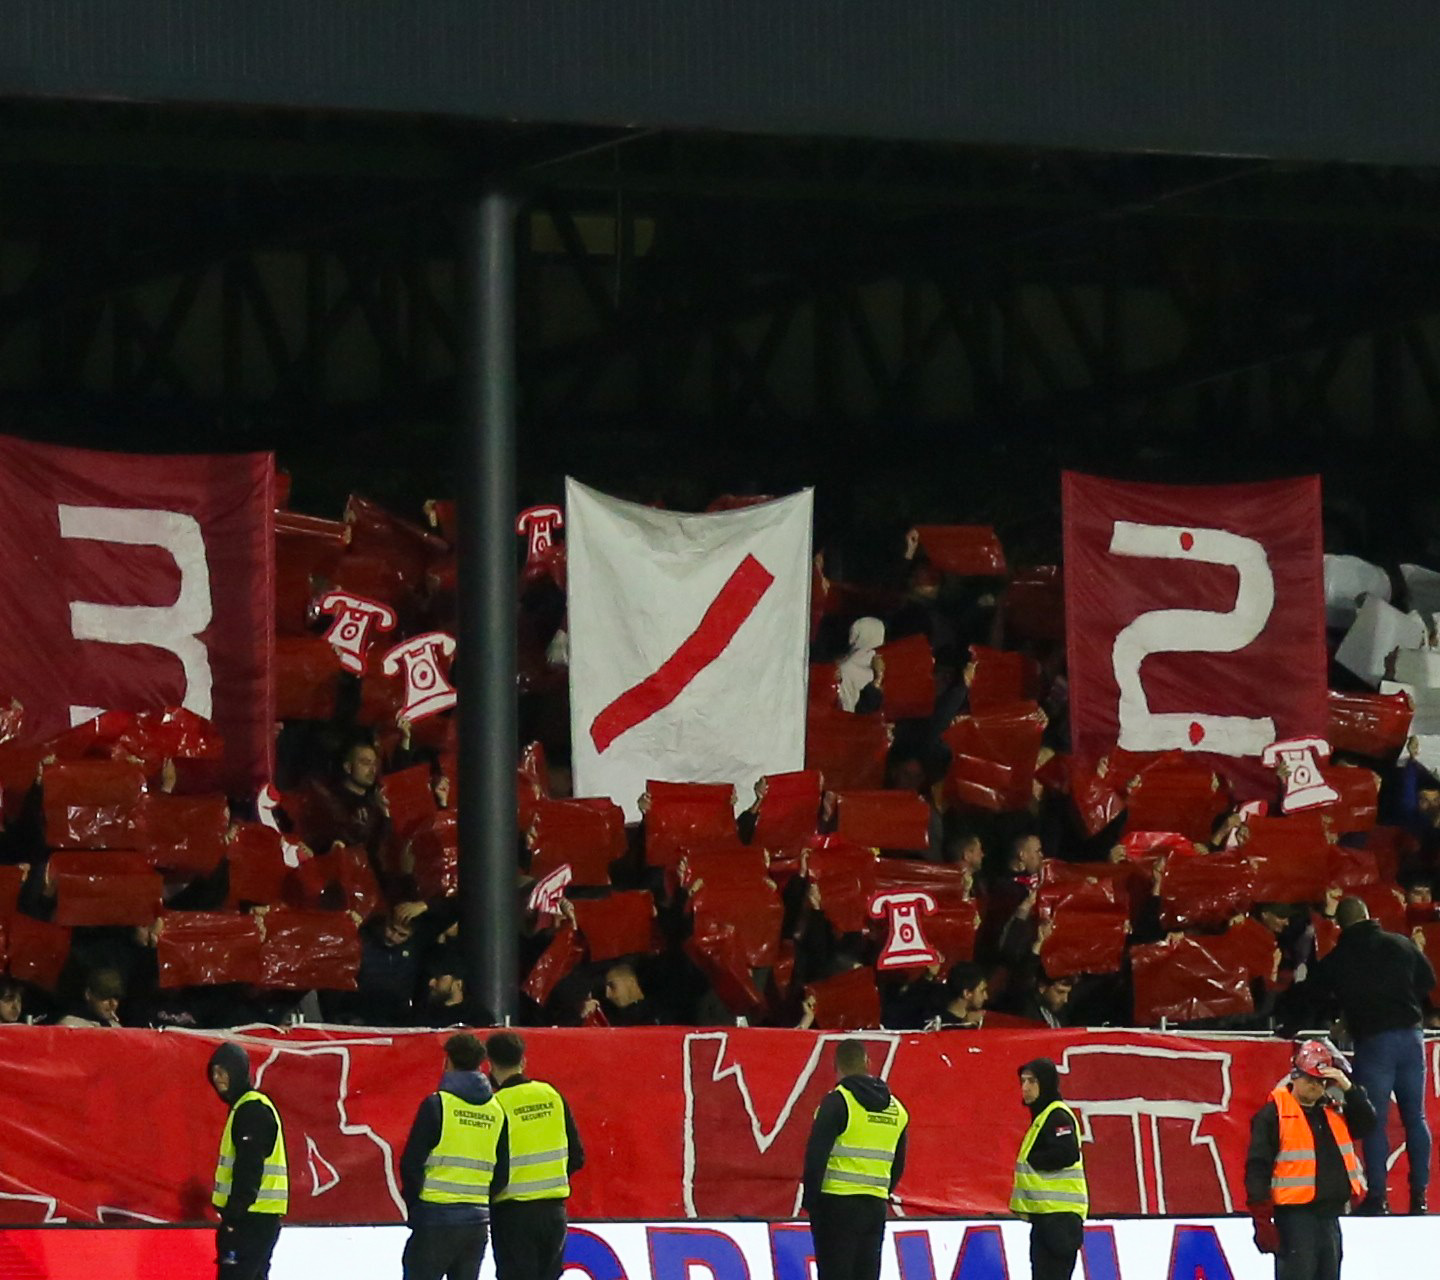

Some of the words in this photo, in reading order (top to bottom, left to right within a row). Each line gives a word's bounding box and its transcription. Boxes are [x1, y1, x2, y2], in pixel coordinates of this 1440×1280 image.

[58, 504, 214, 730] 3
[1108, 521, 1275, 756] 2
[459, 1118, 492, 1130] SECURITY
